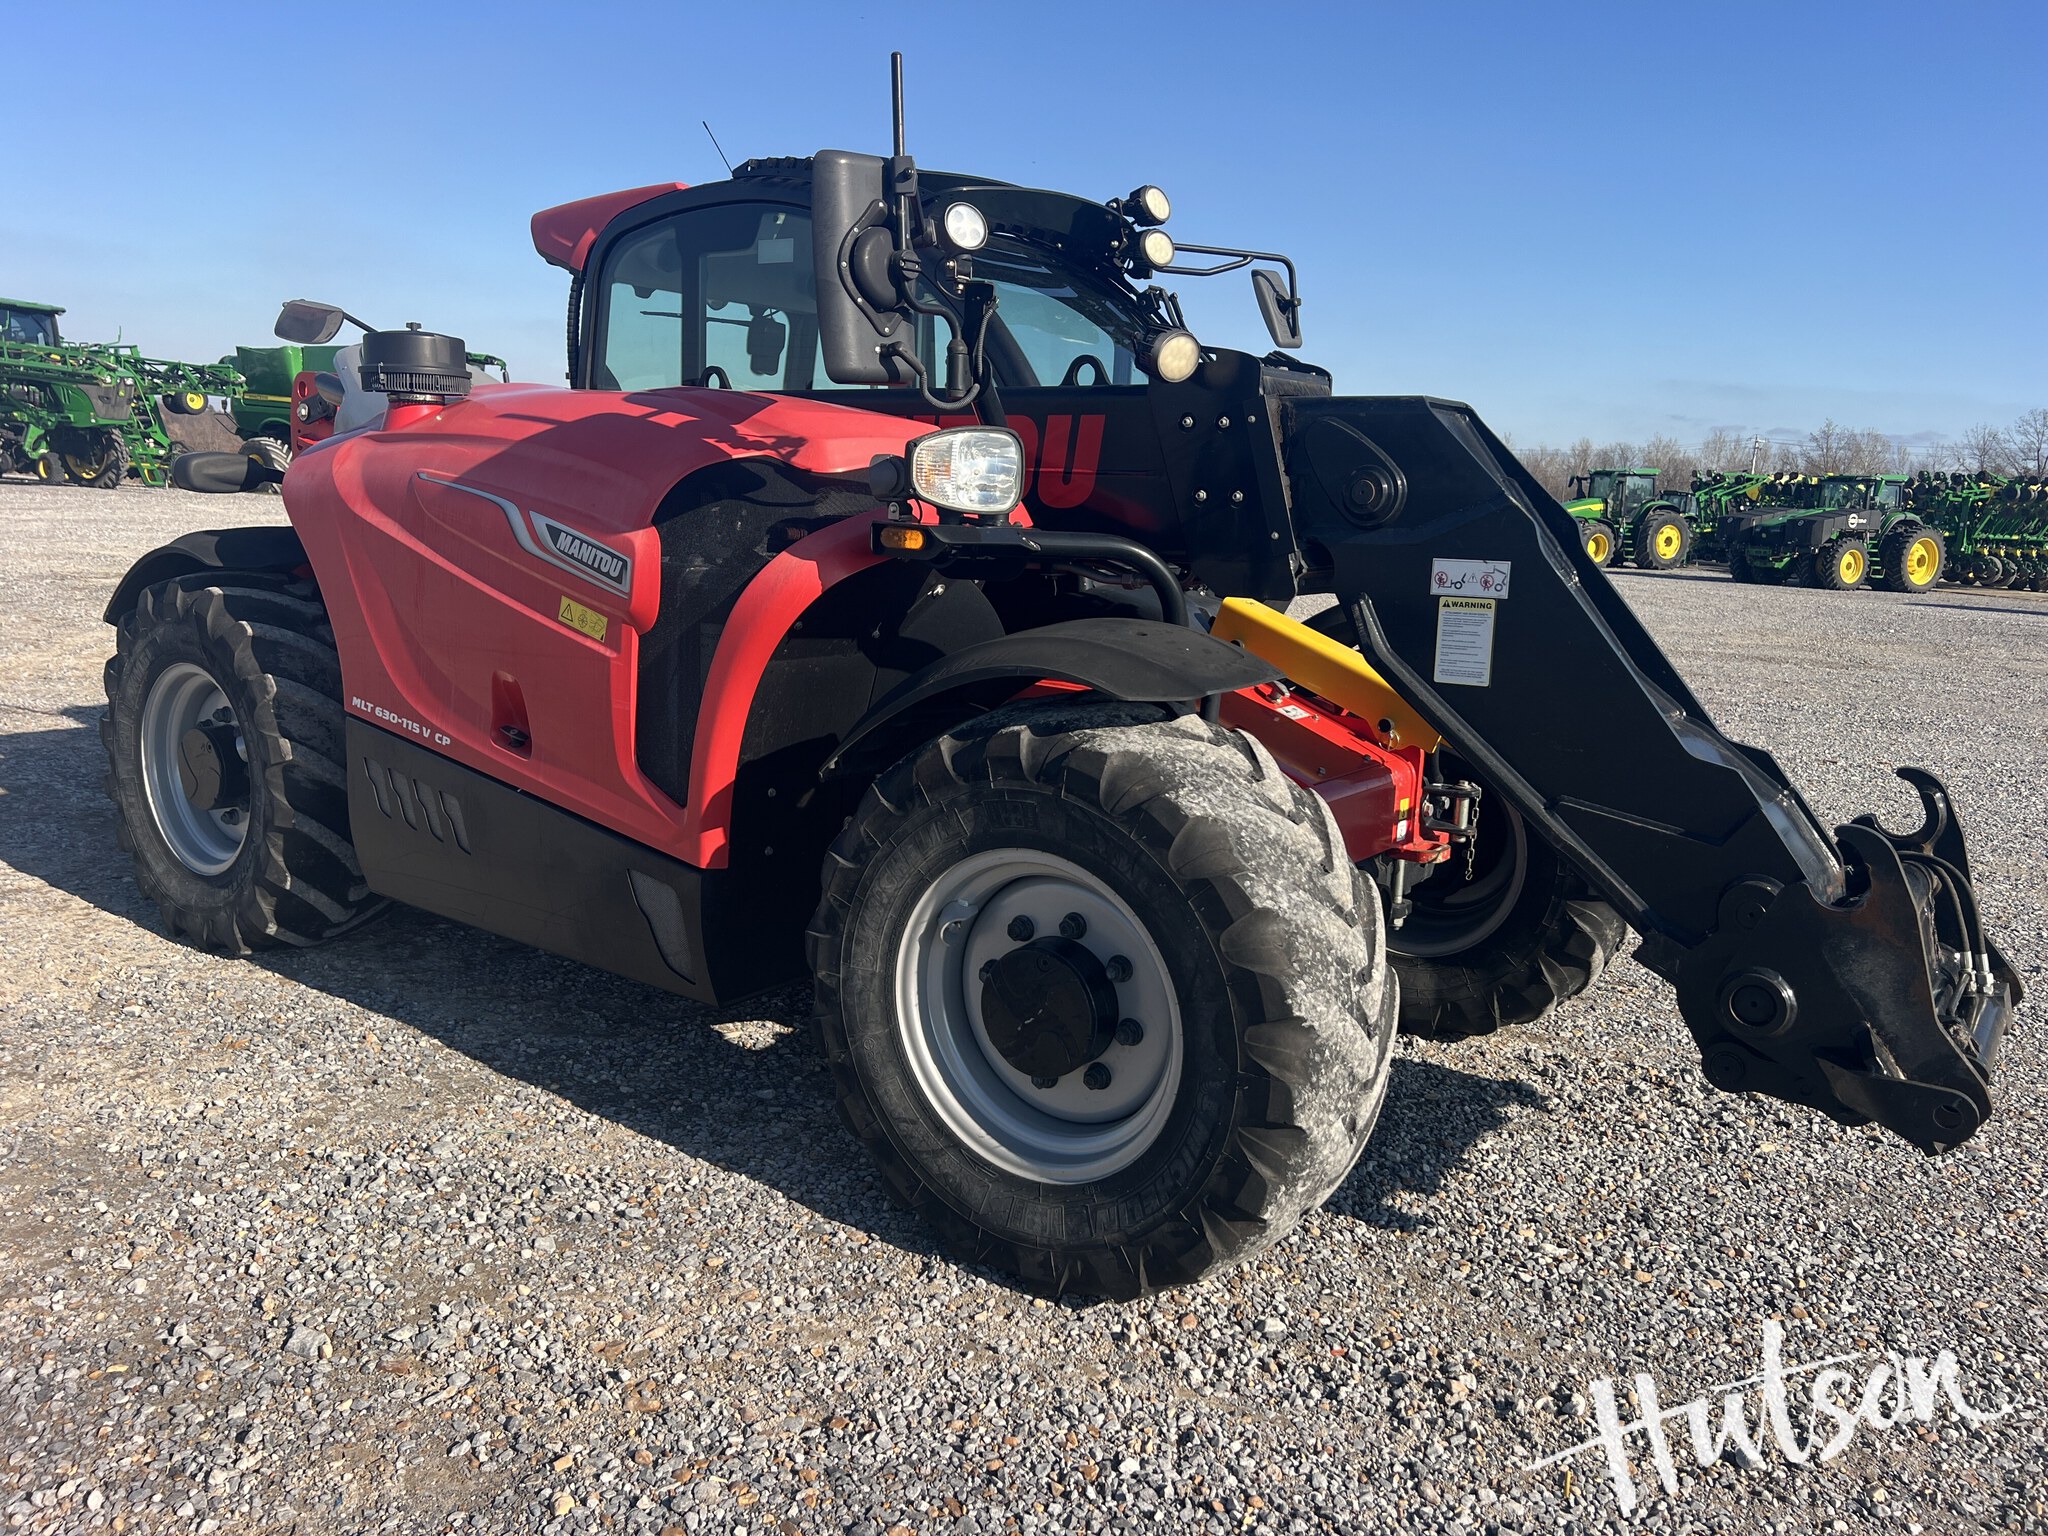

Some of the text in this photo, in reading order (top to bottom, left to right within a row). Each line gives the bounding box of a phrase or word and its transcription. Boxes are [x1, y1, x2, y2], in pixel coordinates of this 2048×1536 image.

[556, 531, 623, 578] MANITOU
[1451, 601, 1492, 610] WARNING
[352, 696, 451, 746] MLT 630-115 V CP
